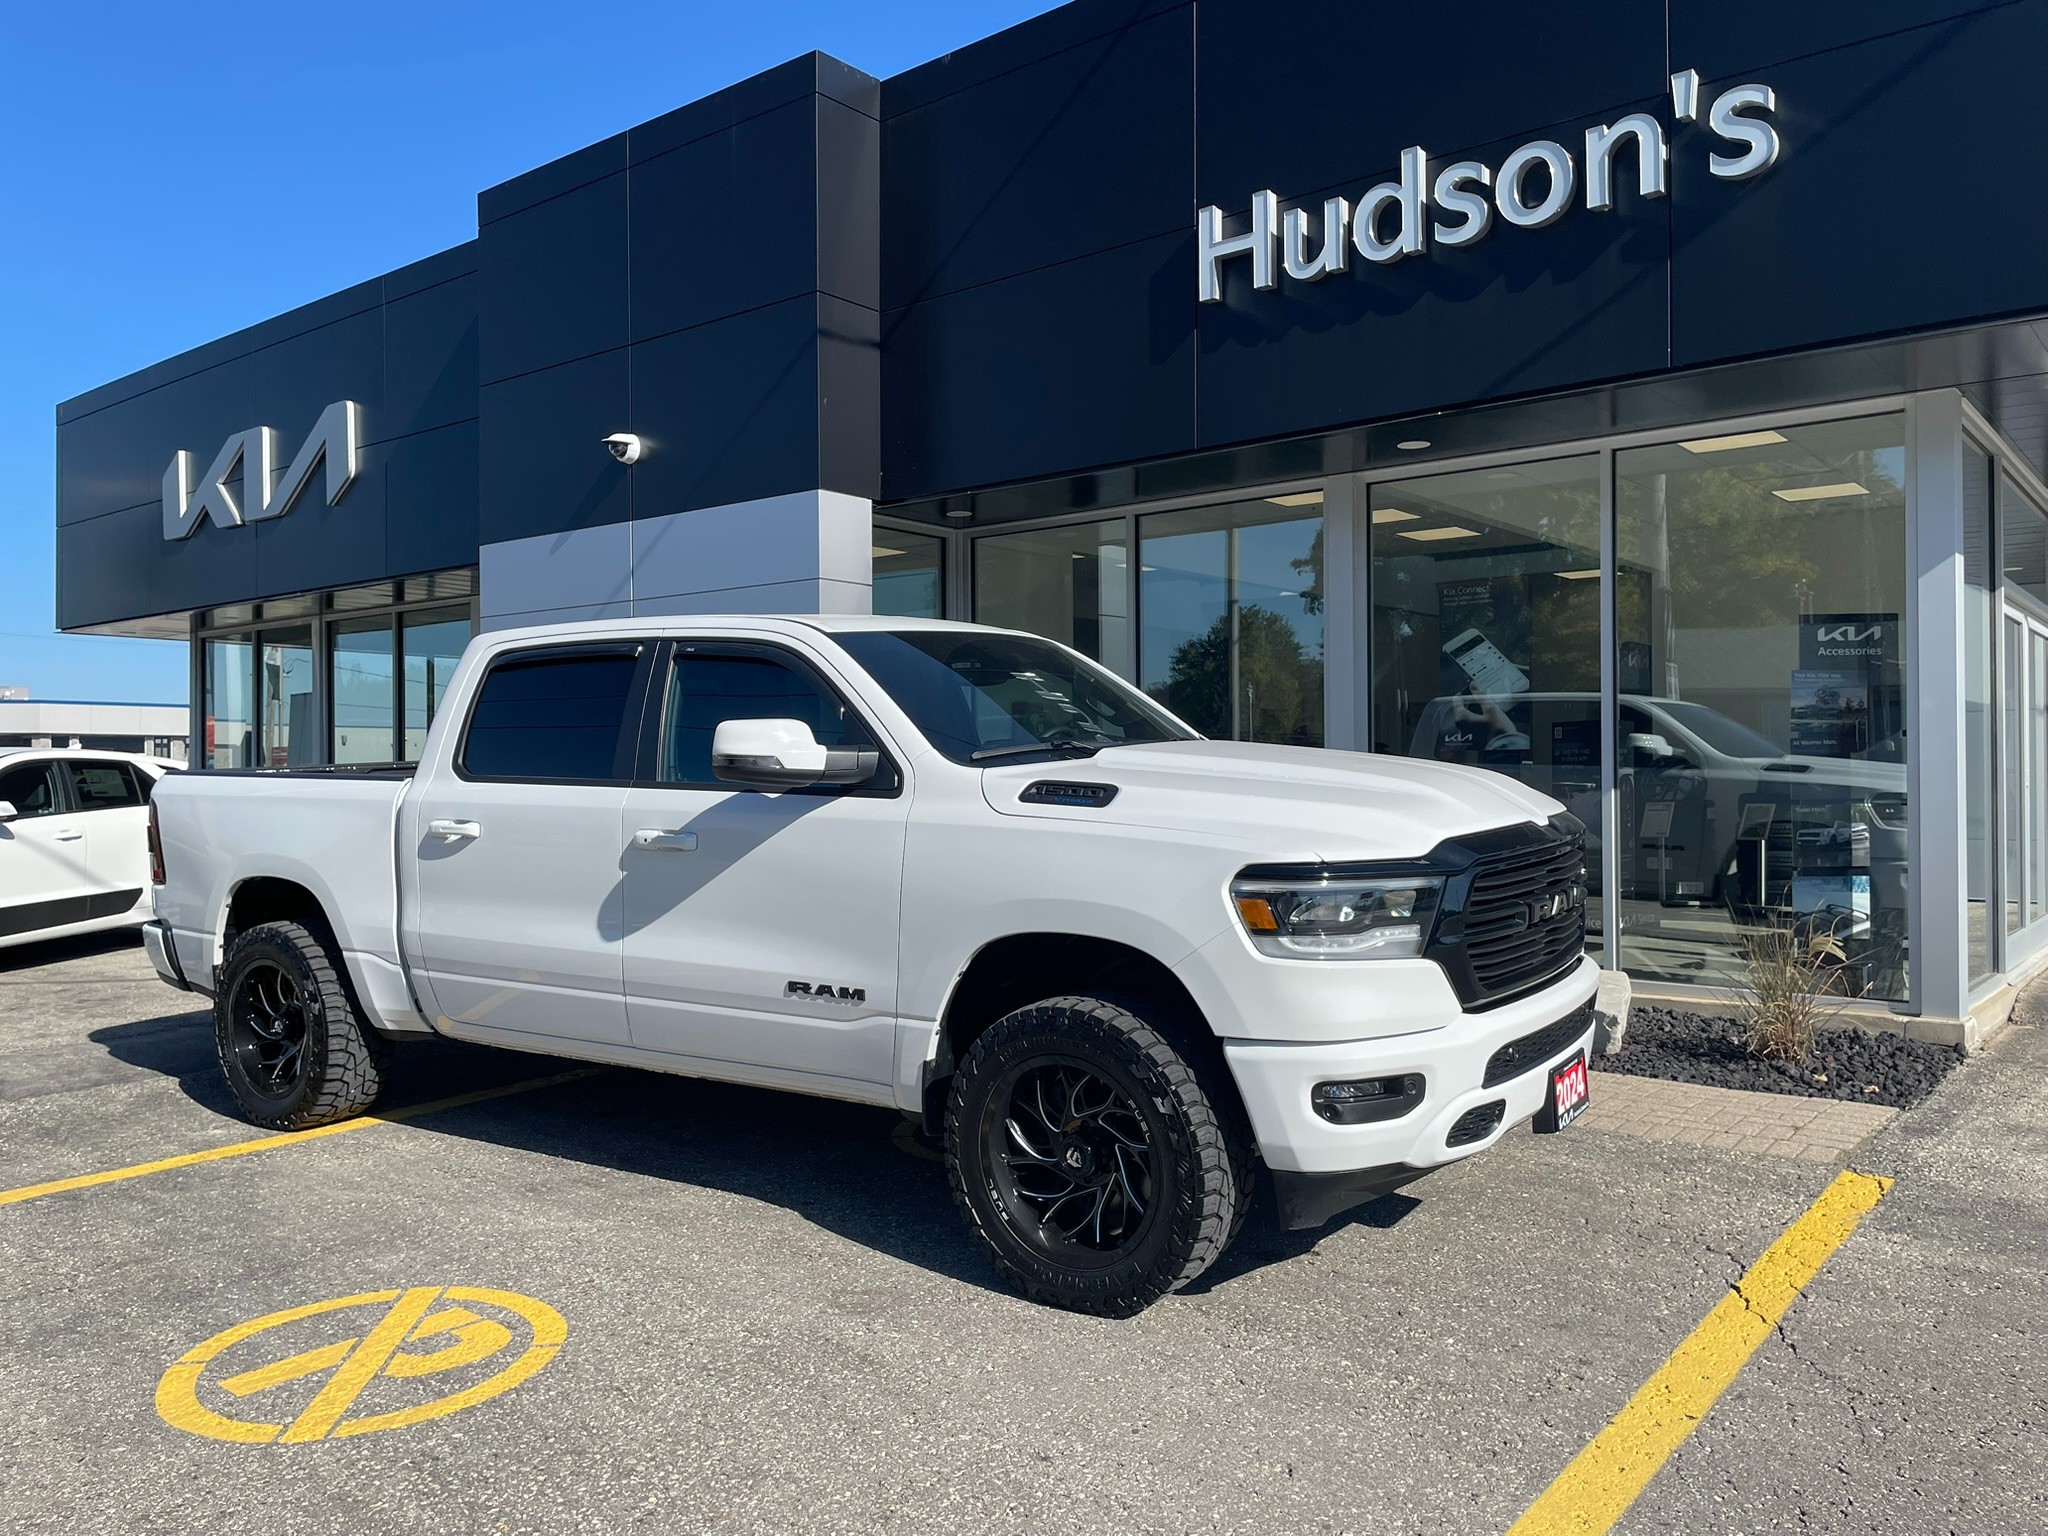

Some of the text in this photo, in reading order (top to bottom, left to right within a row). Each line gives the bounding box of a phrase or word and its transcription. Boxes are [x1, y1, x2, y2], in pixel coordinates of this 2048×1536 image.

[1199, 68, 1780, 302] Hudson's
[162, 400, 358, 541] KIA
[1817, 626, 1882, 641] KIA
[1818, 646, 1882, 656] Accessories
[787, 980, 866, 1002] RAM
[1556, 1065, 1585, 1116] 2024
[1127, 1099, 1151, 1144] FUEL
